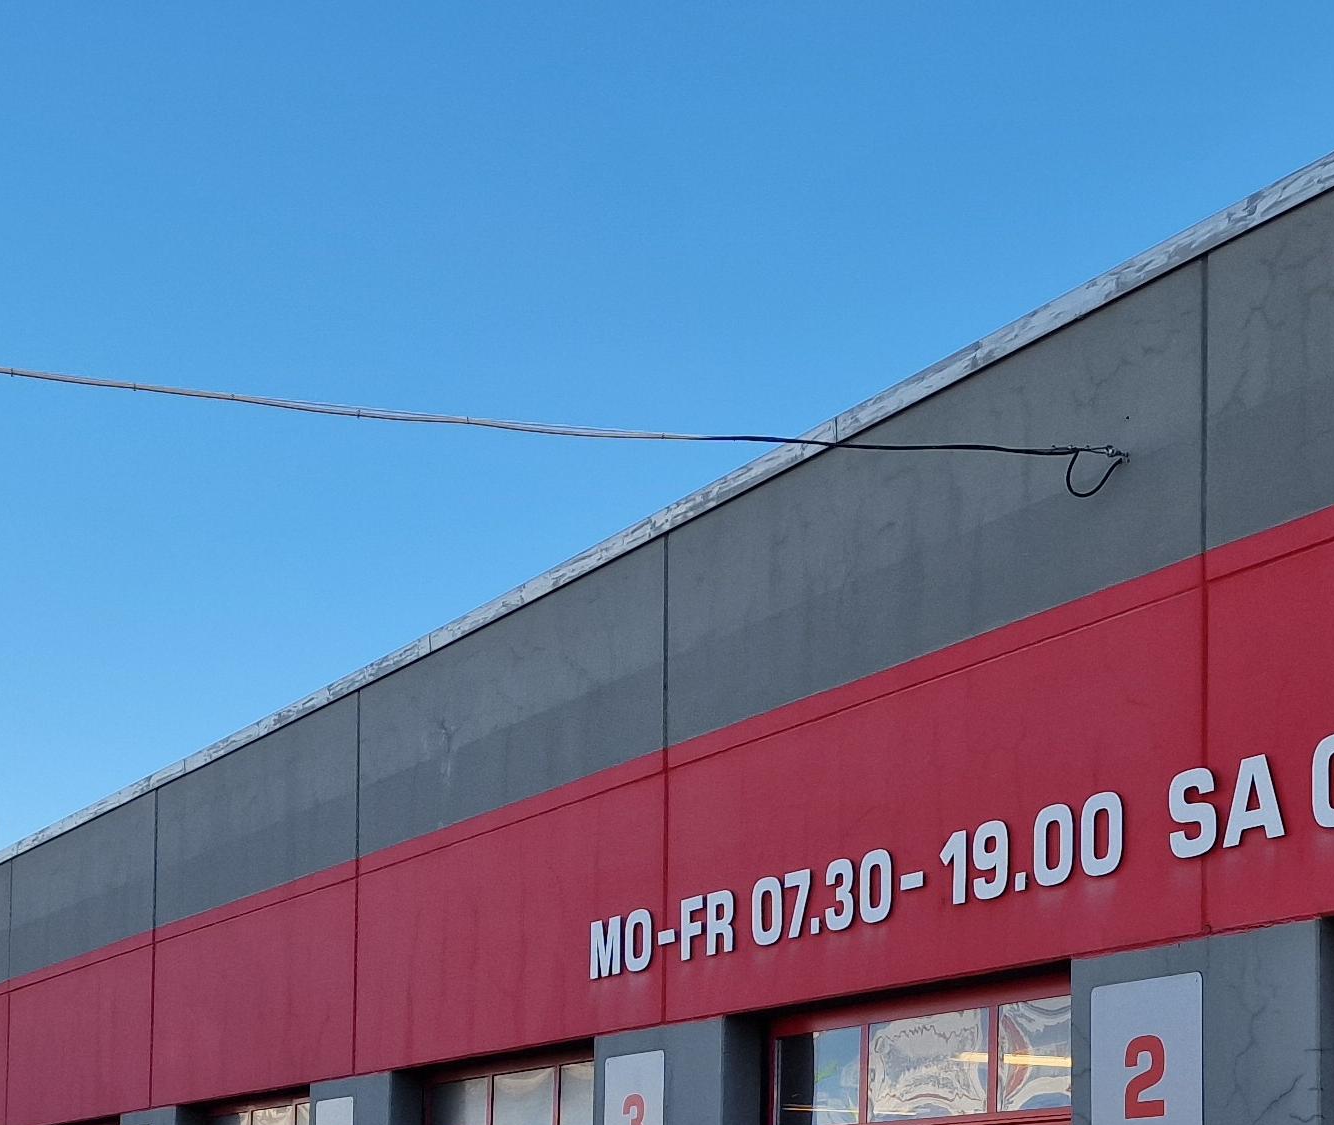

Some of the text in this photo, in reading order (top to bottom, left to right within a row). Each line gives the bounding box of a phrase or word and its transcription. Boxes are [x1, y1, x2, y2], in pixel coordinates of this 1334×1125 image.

[589, 869, 735, 980] MO-FR
[1168, 754, 1286, 859] SA
[1123, 1034, 1165, 1119] 2
